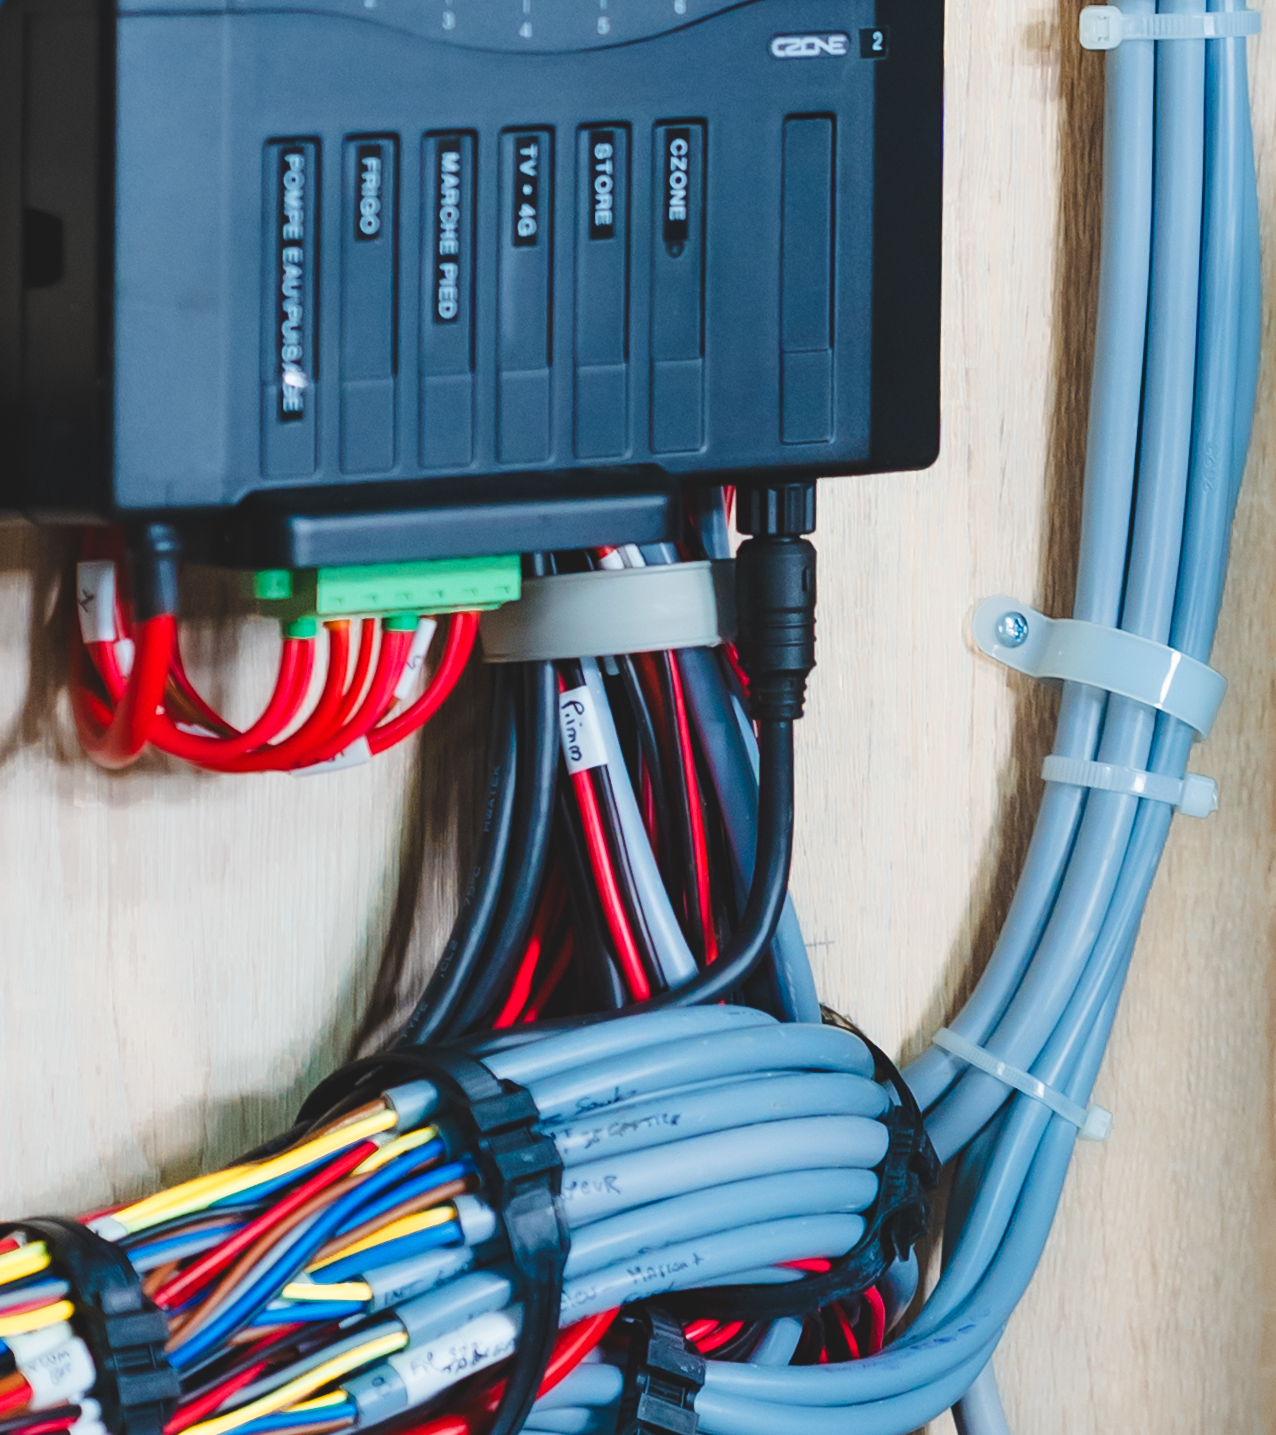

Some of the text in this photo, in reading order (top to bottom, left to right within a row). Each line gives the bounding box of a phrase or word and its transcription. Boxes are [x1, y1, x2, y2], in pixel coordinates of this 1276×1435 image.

[519, 21, 532, 38] 4
[771, 31, 883, 57] CZONE 2
[283, 154, 304, 240] POMPE
[359, 156, 381, 235] FRIGO
[517, 143, 537, 237] TV 4G
[594, 143, 613, 226] STORE
[668, 138, 688, 220] CZONE
[439, 152, 460, 319] MARCHE PIED
